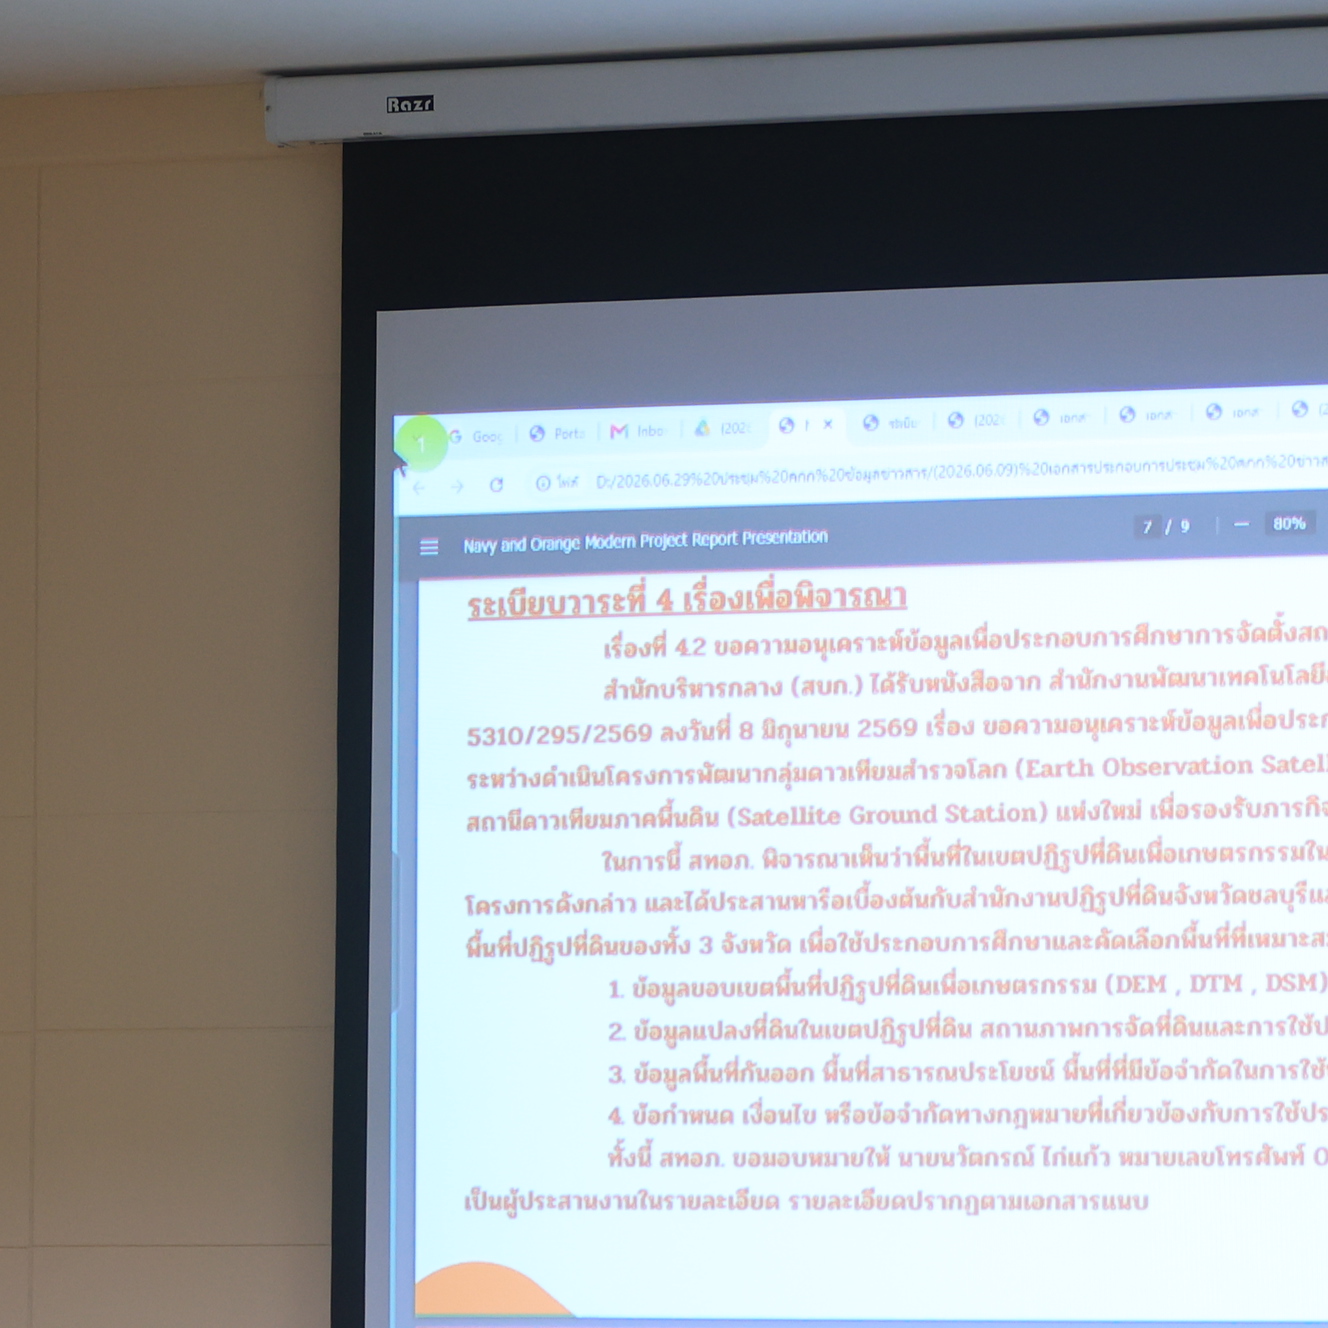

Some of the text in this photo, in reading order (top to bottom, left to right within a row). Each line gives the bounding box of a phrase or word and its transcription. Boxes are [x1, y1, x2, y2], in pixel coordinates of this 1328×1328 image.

[388, 97, 431, 112] Razr
[1143, 518, 1190, 535] 7 / 9
[1273, 515, 1306, 531] 80%
[463, 530, 828, 556] Navy and Orange Modern Project Report Presentation
[468, 574, 907, 618] ระเบียบวาระที่ 4 เรื่องเพื่อพิจารณา
[605, 629, 668, 659] เรื่องที่
[605, 676, 784, 701] สำนักบริหารกลาง
[792, 674, 864, 698] (สบก.)
[871, 669, 1042, 695] ได้รับหนังสือจาก
[468, 723, 653, 747] 5310/295/2569
[661, 713, 732, 742] ลงวันที่
[740, 721, 755, 740] 8
[763, 717, 850, 748] มิถุนายน
[859, 718, 919, 738] 2569
[927, 708, 975, 736] เรื่อง
[1016, 758, 1095, 780] (Earth
[1103, 755, 1254, 777] Observation
[468, 798, 720, 832] สถานีดาวเทียมภาคพื้นดิน
[729, 806, 842, 829] (Satellite
[850, 803, 937, 825] Ground
[945, 801, 1049, 824] Station)
[1058, 799, 1143, 821] แห่งใหม่
[602, 841, 683, 872] ในการนี้
[690, 854, 755, 871] สทอภ.
[465, 891, 638, 916] โครงการดังกล่าว
[467, 926, 692, 966] พื้นที่ปฏิรูปที่ดินของทั้ง
[700, 936, 714, 955] 3
[723, 931, 792, 954] จังหวัด
[610, 980, 625, 998] 1.
[1107, 974, 1168, 995] (DEM
[1191, 974, 1243, 993] DTM
[1267, 971, 1328, 993] DSM)
[610, 1022, 627, 1041] 2.
[609, 1065, 627, 1084] 3.
[635, 1054, 816, 1093] ข้อมูลพื้นที่กันออก
[823, 1053, 1056, 1083] พื้นที่สาธารณประโยชน์
[609, 1107, 626, 1125] 4.
[633, 1102, 735, 1126] ข้อกำหนด
[744, 1097, 817, 1125] เงื่อนไข
[609, 1138, 654, 1168] ทั้งนี้
[661, 1152, 725, 1168] สทอภ.
[734, 1144, 892, 1168] ขอมอบหมายให้
[1120, 1143, 1306, 1167] หมายเลขโทรศัพท์
[465, 1186, 781, 1219] เป็นผู้ประสานงานในรายละเอียด
